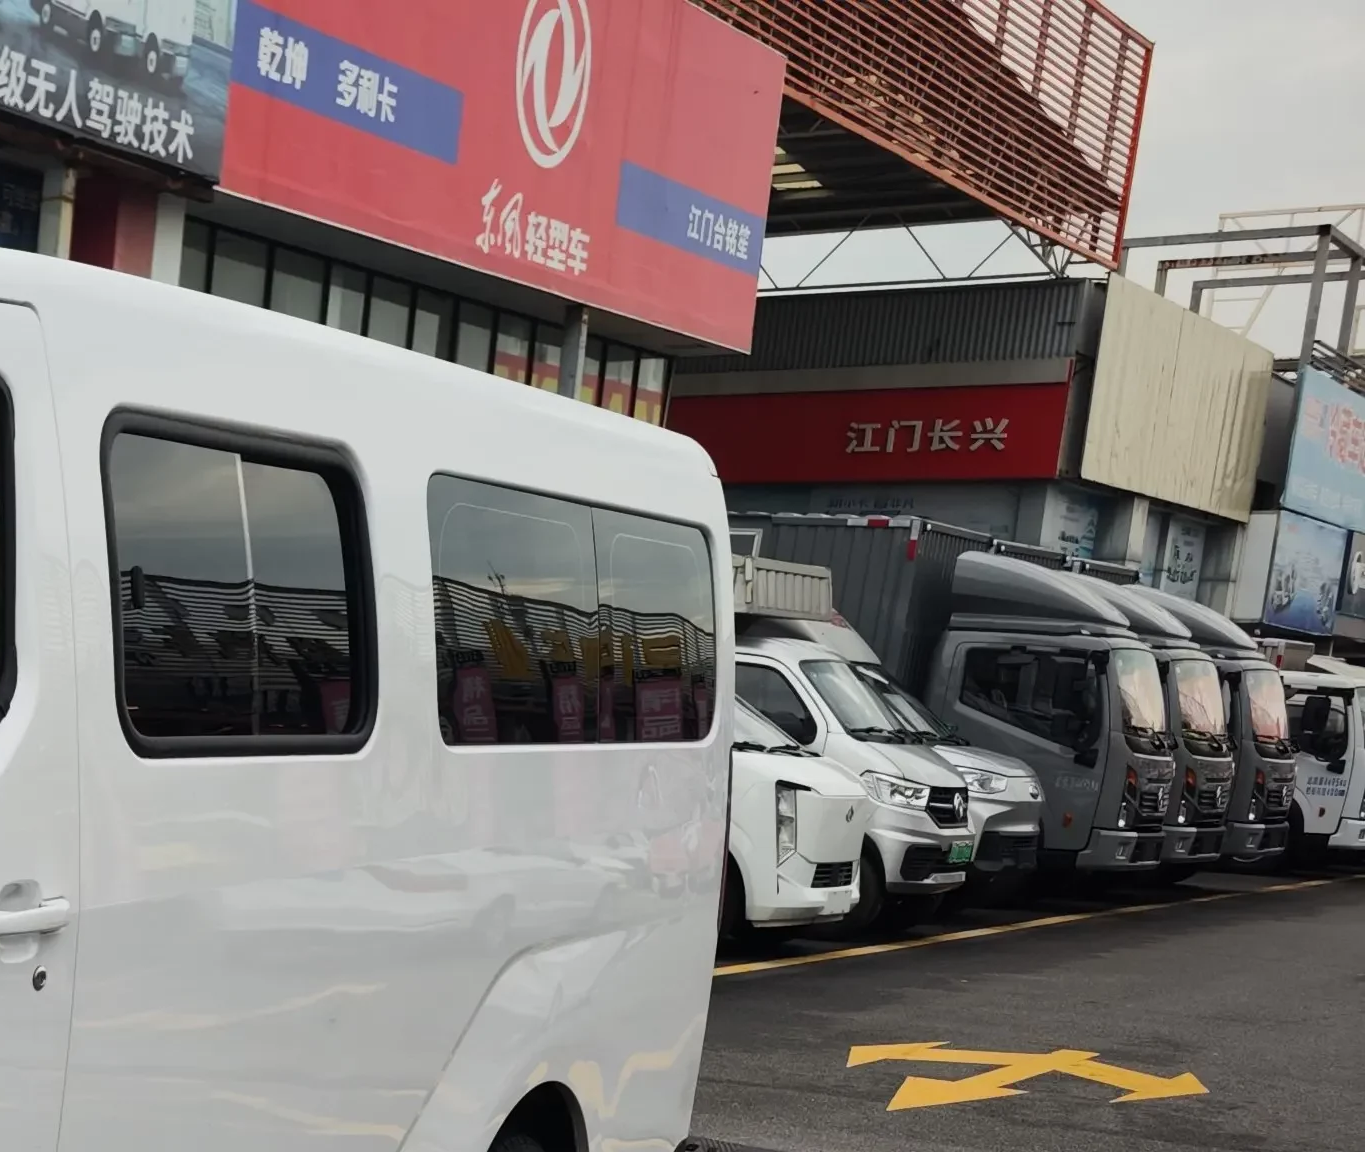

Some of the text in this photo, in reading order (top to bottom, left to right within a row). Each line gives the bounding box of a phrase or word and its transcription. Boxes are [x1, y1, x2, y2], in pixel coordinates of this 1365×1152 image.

[256, 26, 309, 90] 乾坤
[844, 418, 1009, 454] 江门长兴
